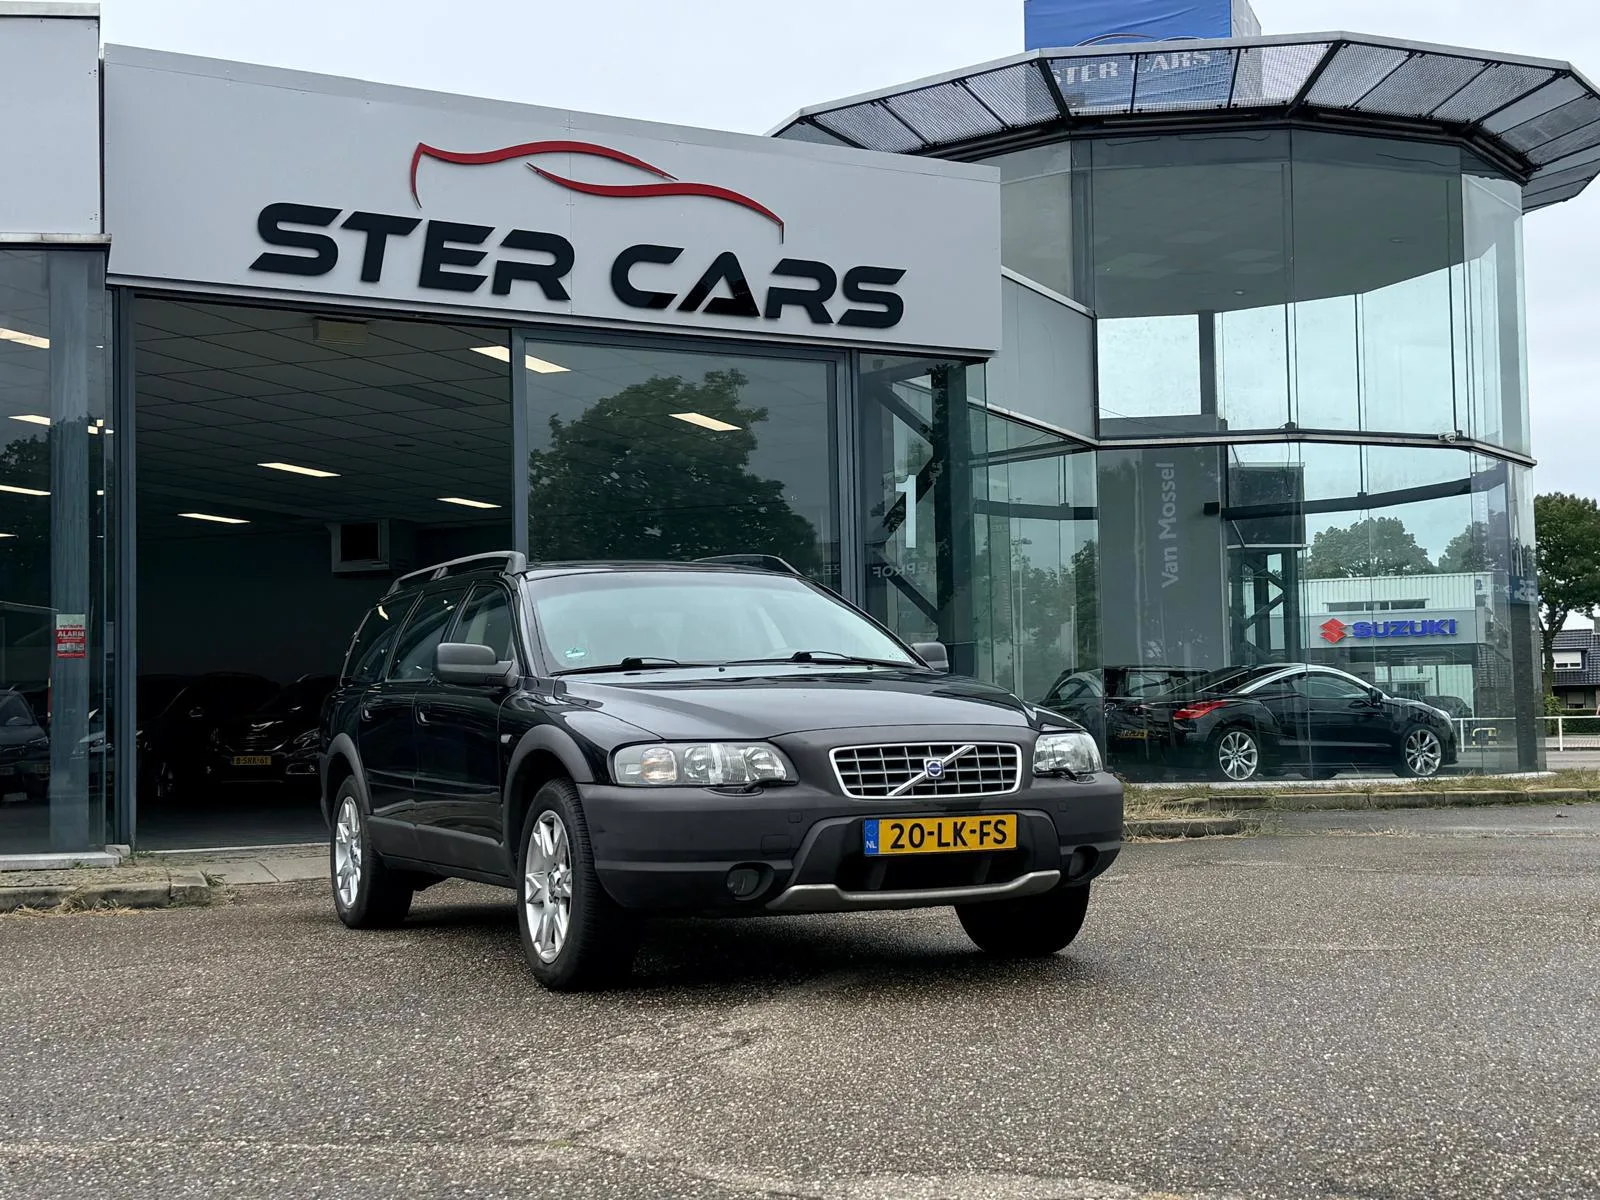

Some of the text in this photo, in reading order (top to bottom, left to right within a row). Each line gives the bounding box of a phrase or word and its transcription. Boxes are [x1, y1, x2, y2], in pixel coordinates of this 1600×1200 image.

[1050, 51, 1211, 85] STER CARS
[249, 202, 907, 329] STER CARS
[1156, 462, 1179, 588] Van Mossel
[57, 630, 85, 638] ALARM
[1352, 619, 1456, 638] SUZUKI
[865, 819, 1008, 850] NL 20-LK-FS
